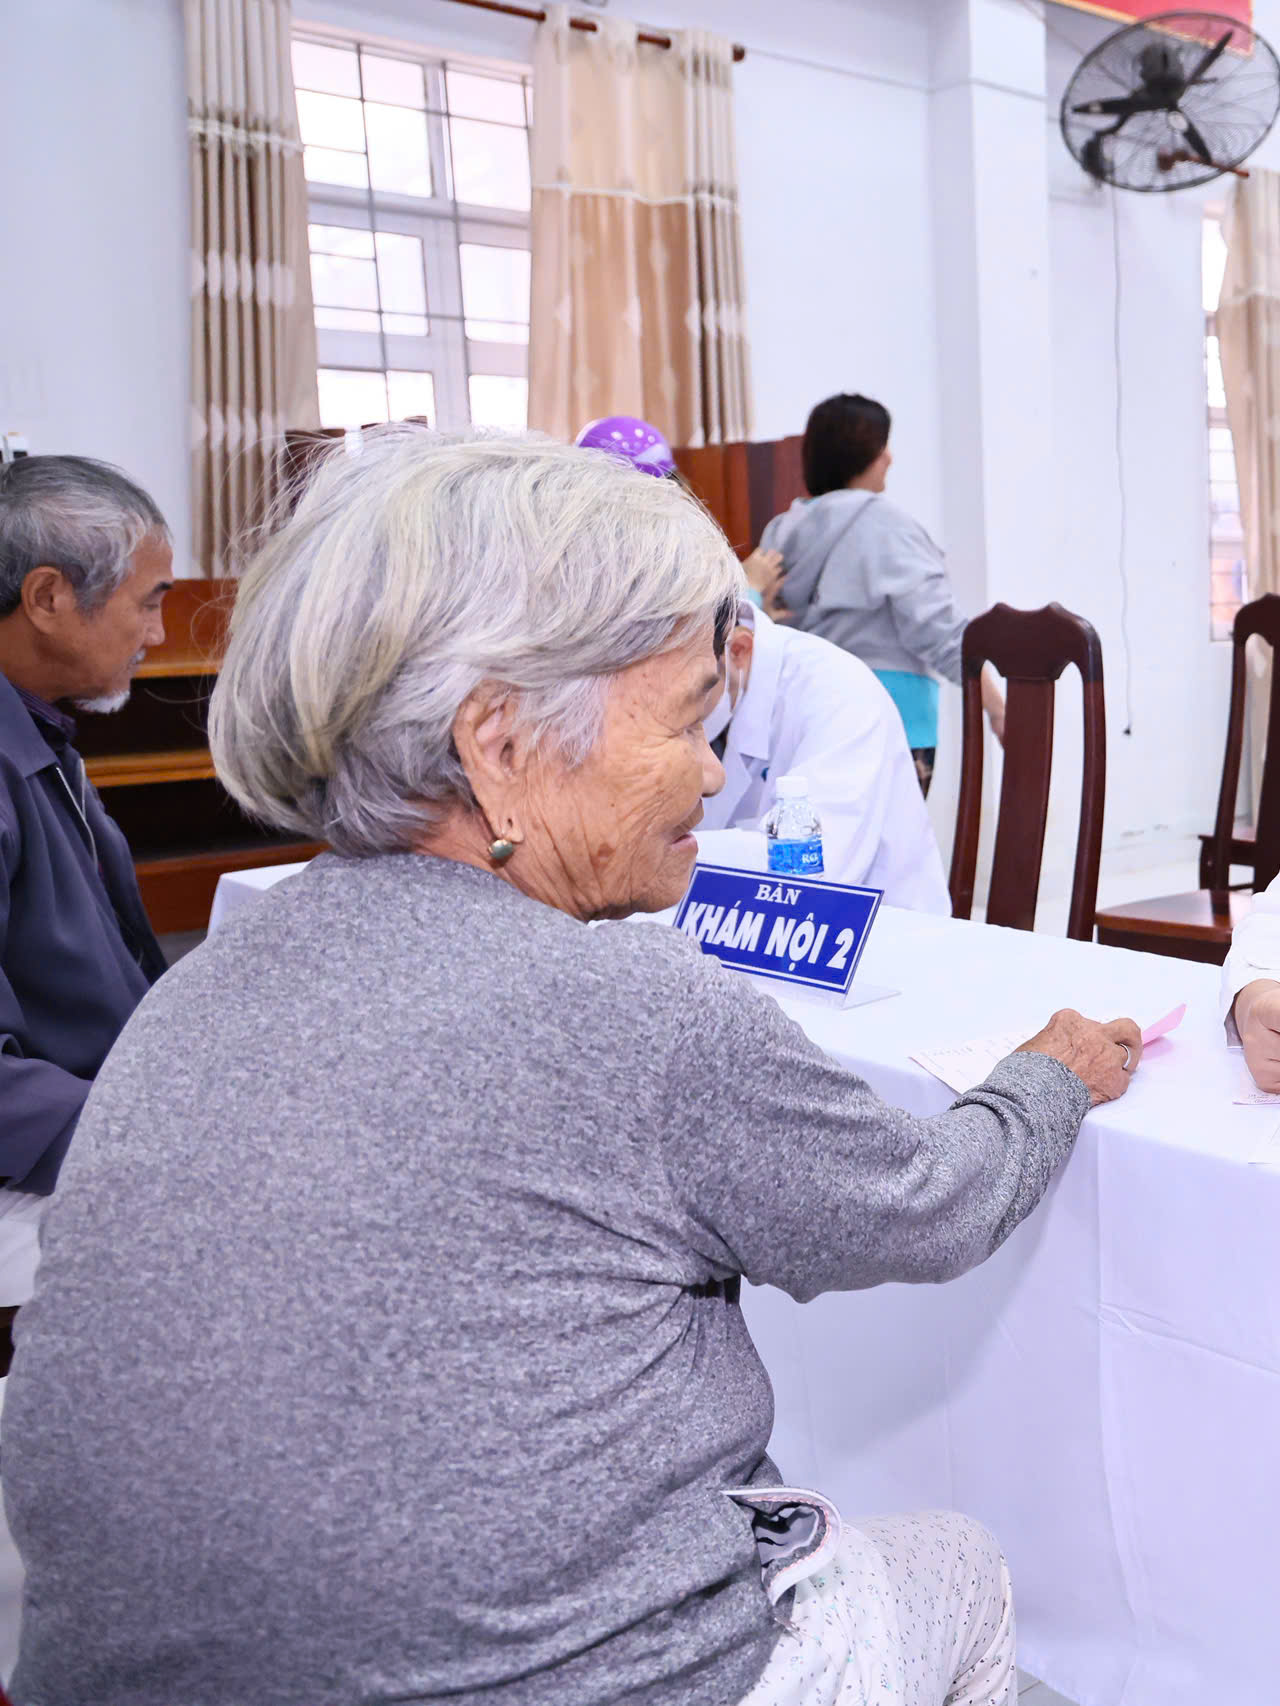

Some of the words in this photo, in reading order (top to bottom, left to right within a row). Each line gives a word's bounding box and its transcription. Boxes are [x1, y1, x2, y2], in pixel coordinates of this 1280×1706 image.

[755, 882, 802, 906] BÀN
[680, 900, 766, 953] KHÁM
[763, 912, 830, 972] NỘI
[826, 927, 855, 970] 2
